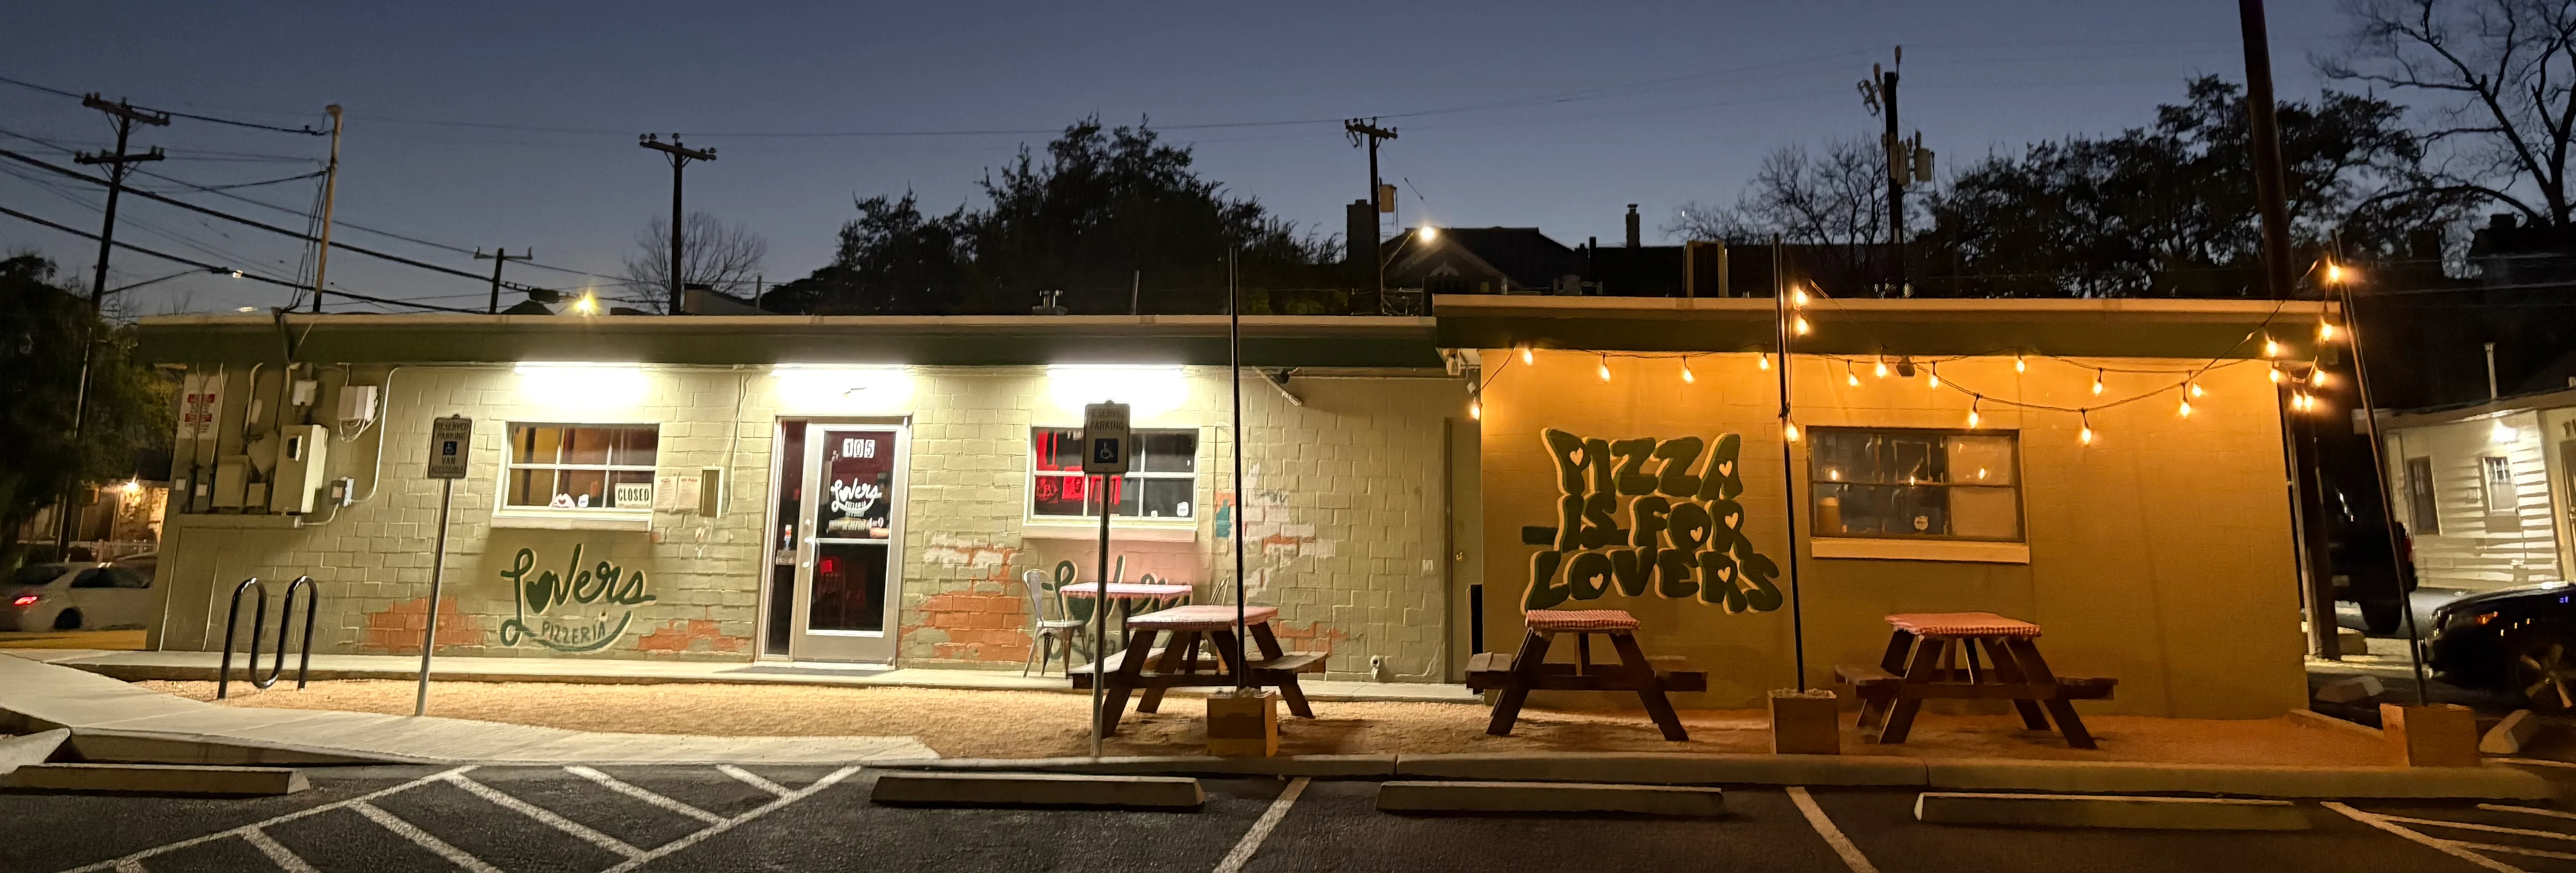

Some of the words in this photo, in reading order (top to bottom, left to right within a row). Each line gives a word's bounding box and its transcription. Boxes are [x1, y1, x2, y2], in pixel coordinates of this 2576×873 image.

[1088, 408, 1128, 418] RESERVED
[436, 422, 470, 431] RESERVED
[1090, 420, 1124, 431] PARKING
[437, 432, 466, 440] PARKING
[845, 440, 874, 458] 105
[442, 457, 456, 465] VAN
[1541, 427, 1743, 501] PIZZA
[618, 487, 649, 501] CLOSED
[830, 478, 882, 513] Lovers
[1554, 493, 1617, 551] IS
[1627, 495, 1753, 554] FOR
[1520, 547, 1783, 616] LOVERS
[500, 543, 657, 647] Lovers
[541, 620, 606, 644] PIZZERIA
